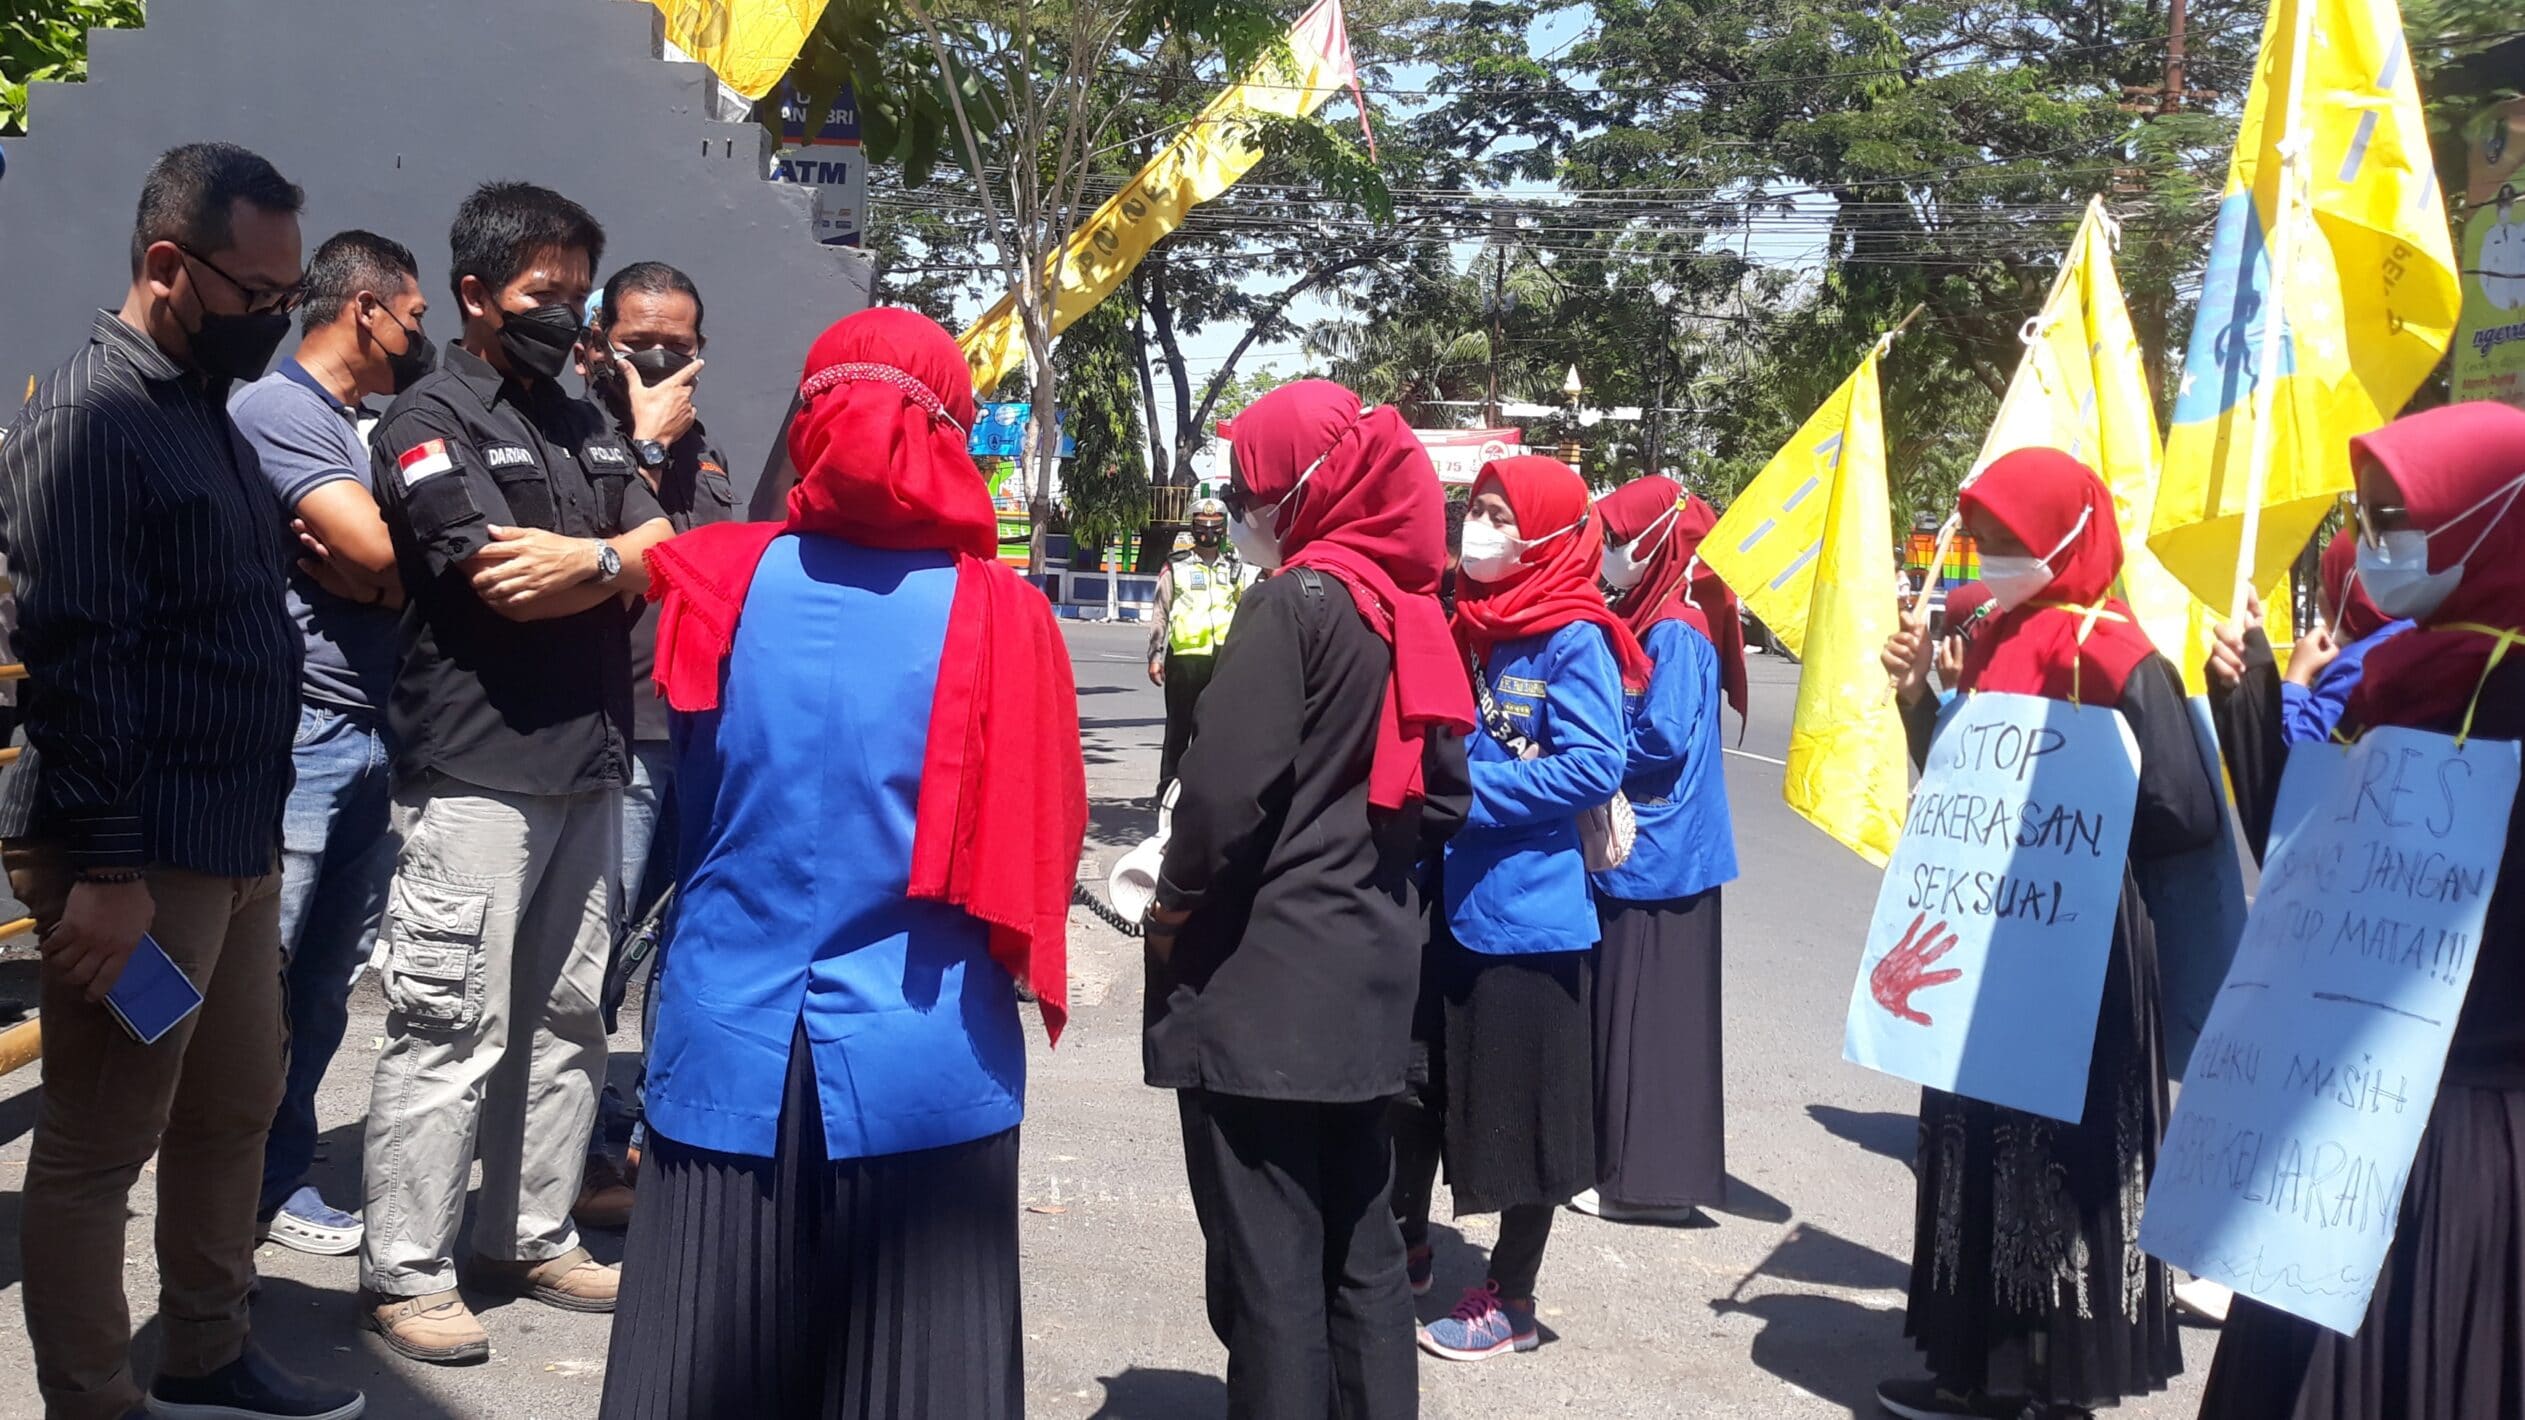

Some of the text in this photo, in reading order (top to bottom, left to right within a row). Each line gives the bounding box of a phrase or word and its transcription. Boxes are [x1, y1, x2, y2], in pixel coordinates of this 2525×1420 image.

[770, 160, 847, 185] ATM
[1953, 721, 2066, 781] STOP
[1907, 793, 2103, 857] KEKERASAN
[1908, 863, 2078, 926] SEKSUAL
[2352, 840, 2484, 903] JANGAN
